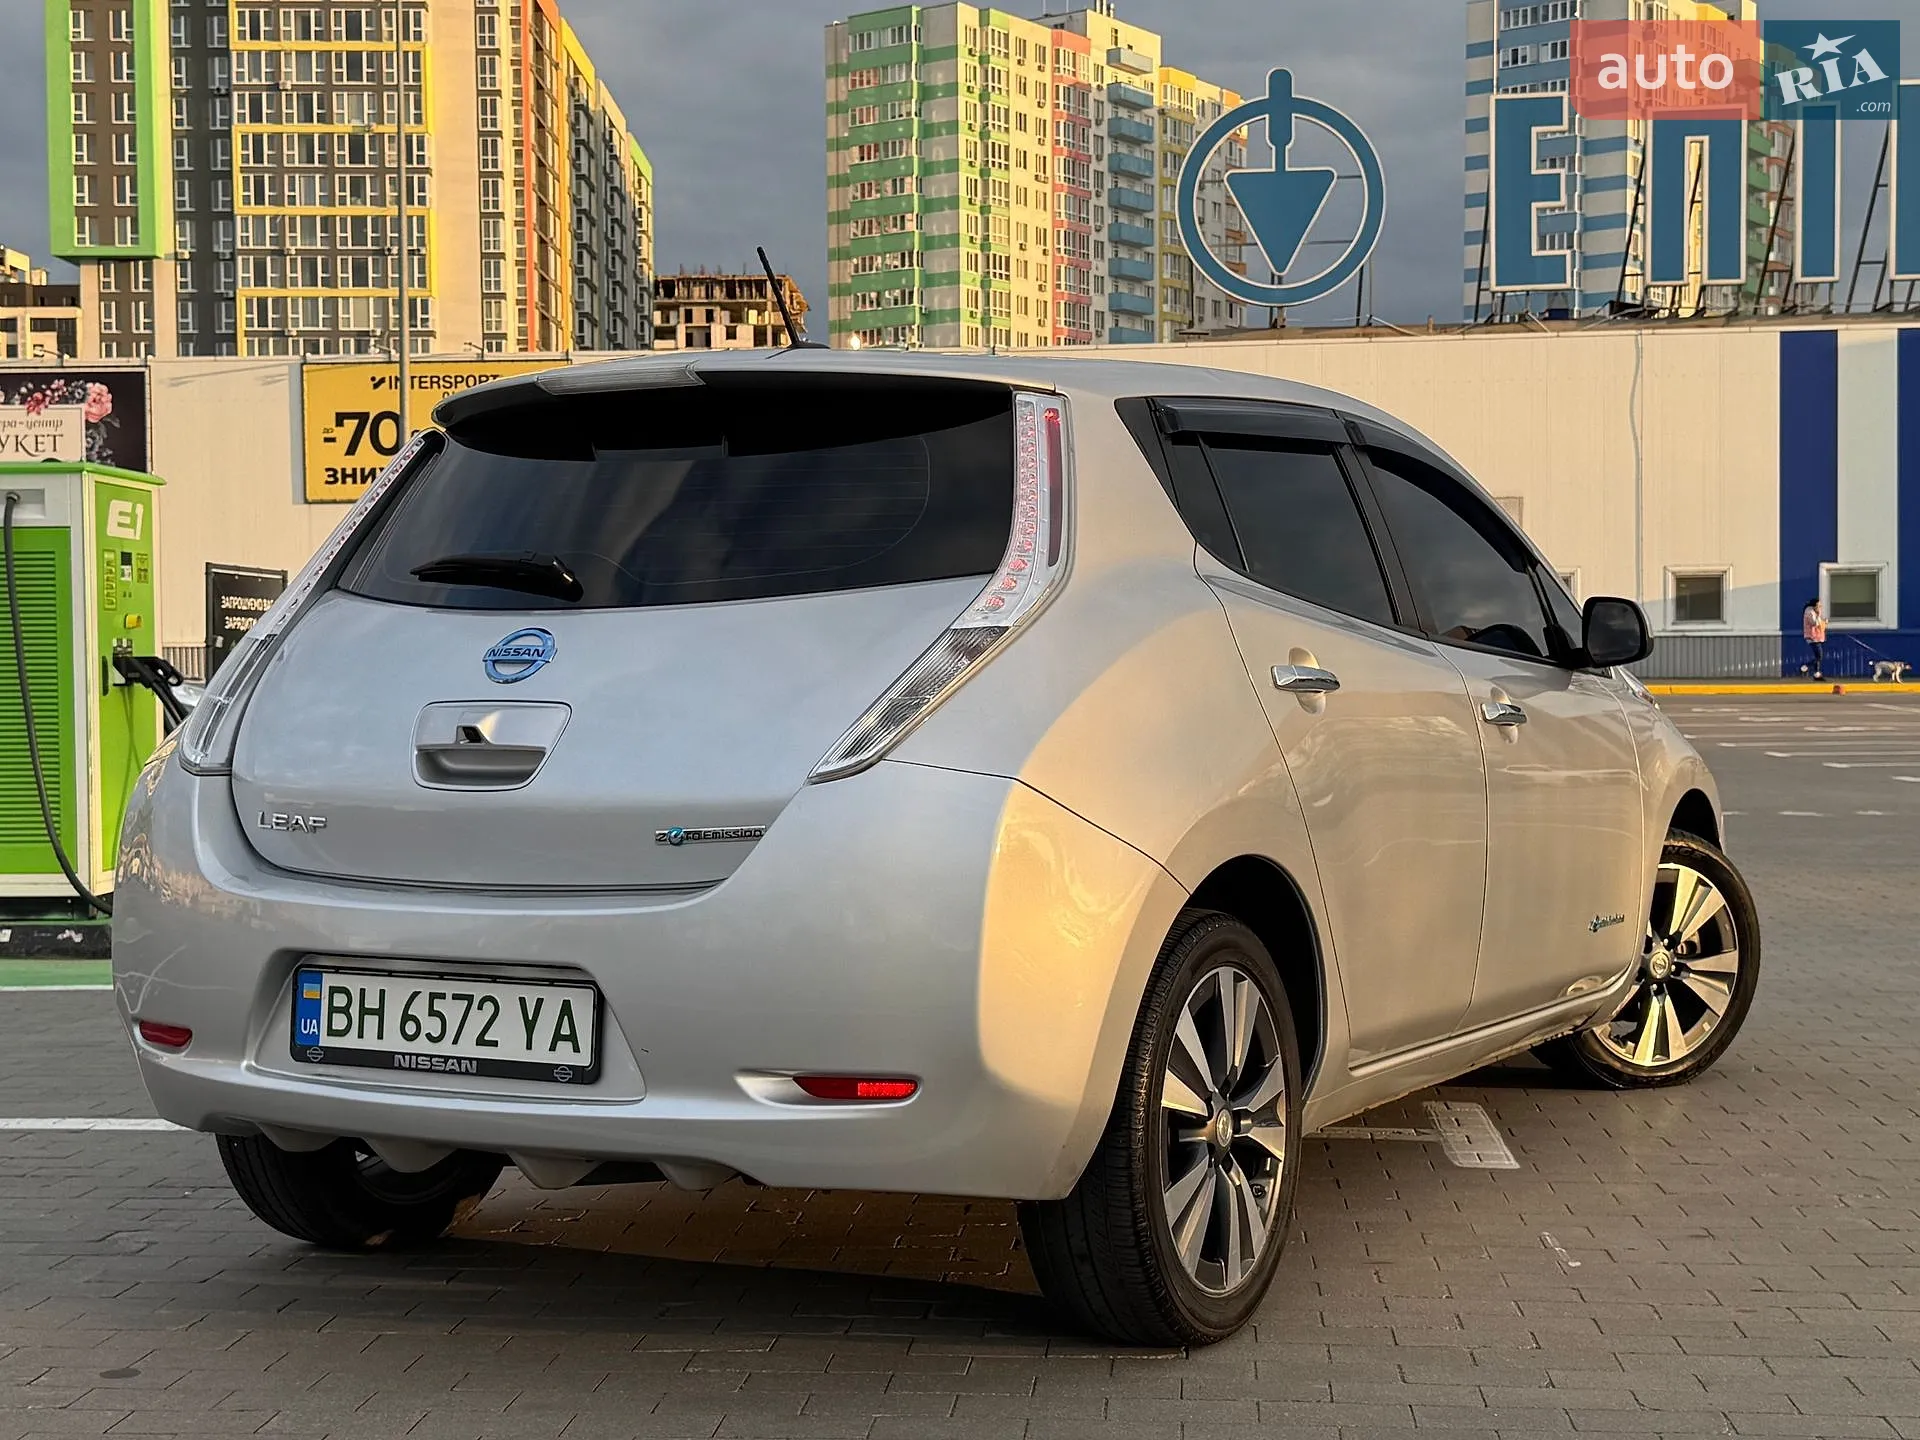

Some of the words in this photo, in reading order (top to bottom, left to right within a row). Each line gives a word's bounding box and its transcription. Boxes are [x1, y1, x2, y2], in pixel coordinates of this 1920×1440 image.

[488, 647, 546, 658] NISSAN
[256, 811, 328, 834] LEAF
[300, 1018, 318, 1036] UA
[326, 985, 387, 1041] BH
[399, 990, 501, 1048] 6572
[518, 996, 581, 1054] YA
[393, 1054, 478, 1074] NISSAN
